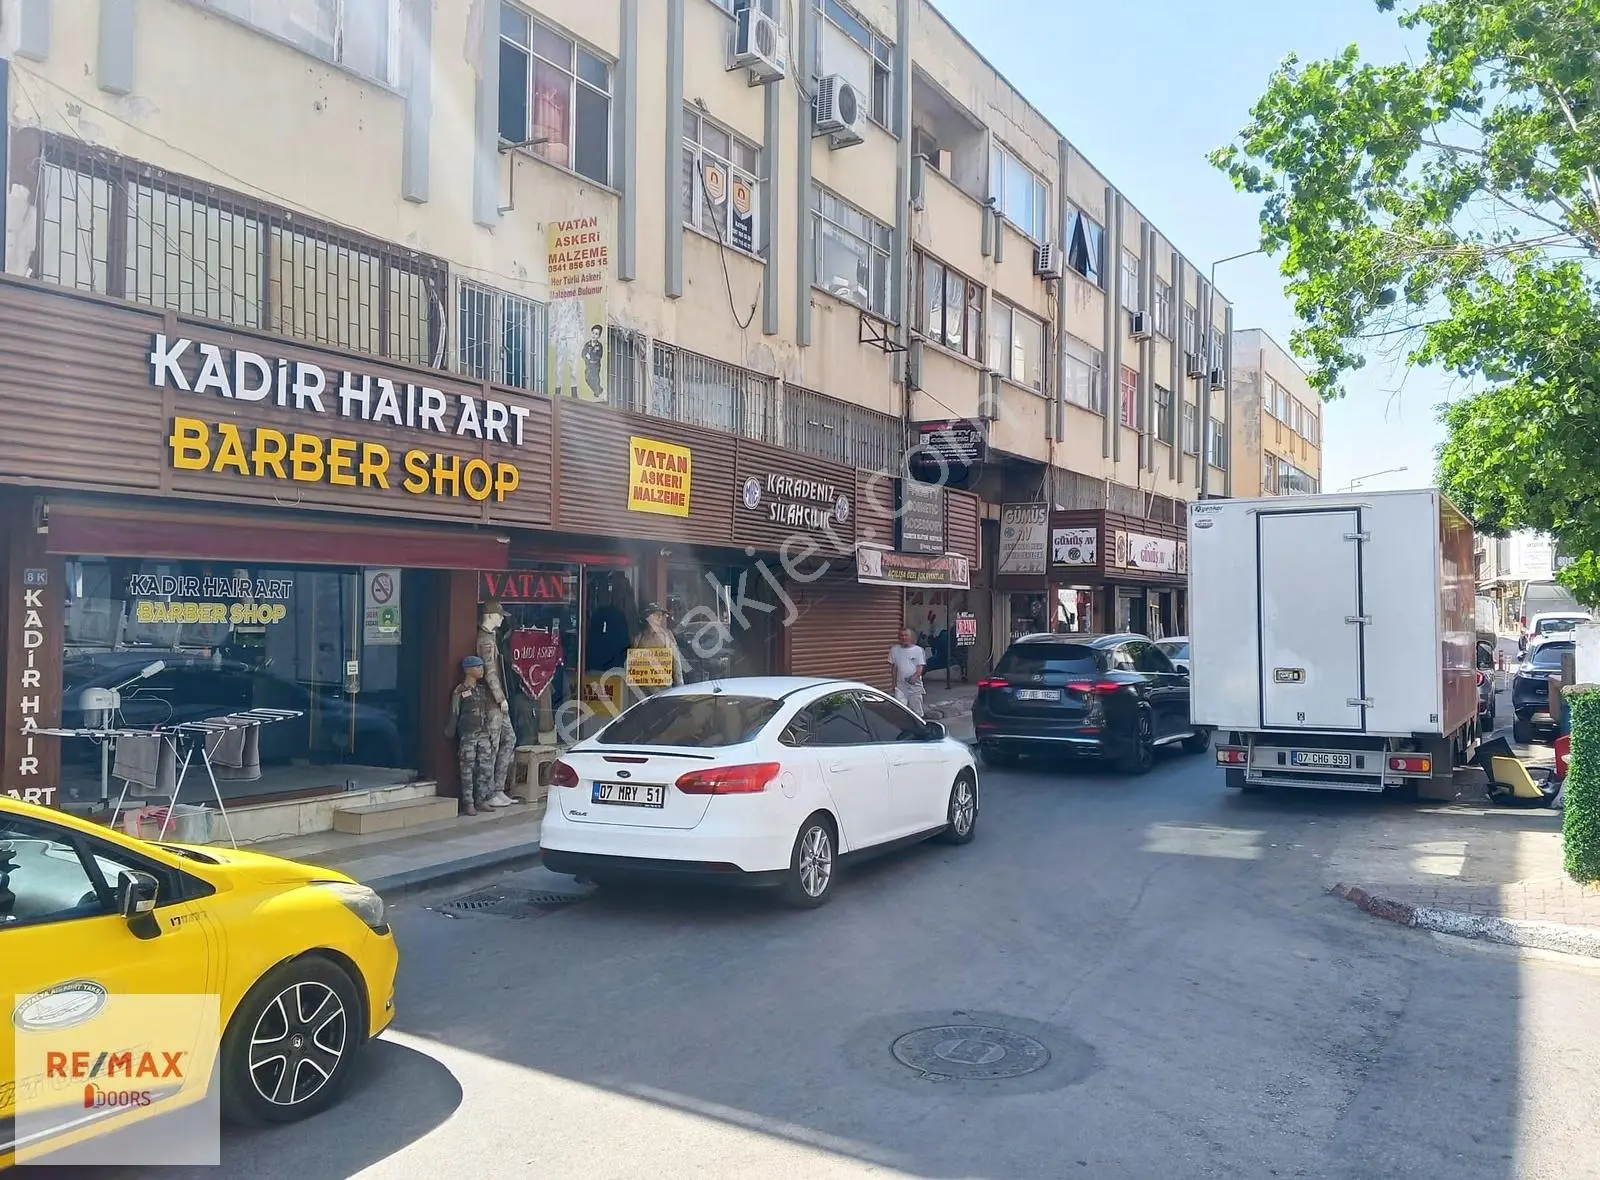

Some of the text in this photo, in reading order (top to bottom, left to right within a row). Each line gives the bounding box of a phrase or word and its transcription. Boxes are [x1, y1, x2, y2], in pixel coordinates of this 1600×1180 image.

[558, 216, 598, 232] VATAN
[555, 232, 601, 248] ASKERİ
[548, 246, 608, 265] MALZEME
[586, 259, 596, 268] 65
[598, 258, 608, 266] 15
[151, 333, 530, 446] KADİR HAIR ART
[169, 416, 521, 503] BARBER SHOP
[634, 447, 688, 474] VATAN
[633, 485, 686, 507] MALZEME
[767, 473, 835, 502] KARADENİZ
[1005, 505, 1046, 526] GÜMÜŞ
[1054, 535, 1084, 547] GÜMÜŞ
[1084, 536, 1095, 545] AV
[130, 574, 293, 599] KADİR HAIR ART
[484, 571, 566, 598] VATAN
[137, 601, 287, 624] BARBER SHOP
[19, 695, 40, 776] HAIR
[1297, 753, 1349, 765] 07 CHG 993
[7, 787, 57, 806] ART
[600, 784, 660, 802] 07 MRY 51
